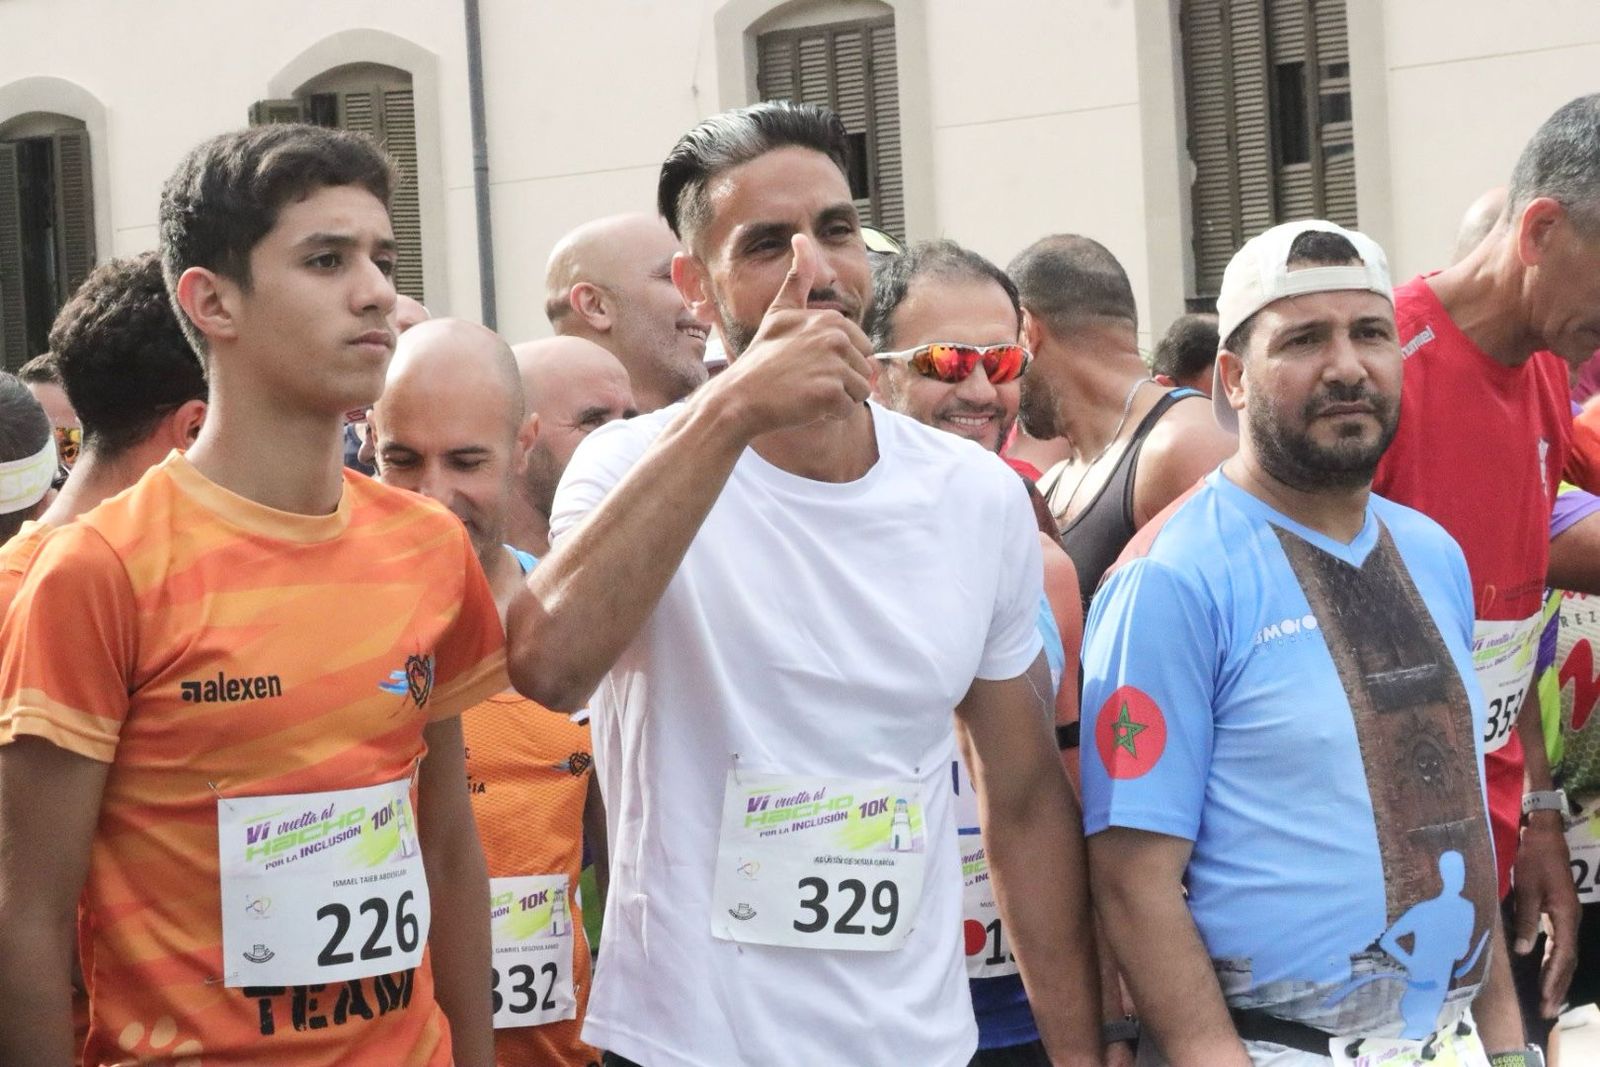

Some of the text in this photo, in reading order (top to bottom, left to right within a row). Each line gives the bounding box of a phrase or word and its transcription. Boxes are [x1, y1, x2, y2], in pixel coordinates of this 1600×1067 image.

[204, 671, 282, 703] alexen
[775, 791, 810, 808] vuelta
[813, 787, 826, 801] al
[859, 797, 890, 819] 10K
[277, 811, 318, 835] vuelta
[321, 803, 335, 821] al
[372, 800, 396, 831] 10K
[792, 810, 848, 832] INCLUSIÓN
[265, 825, 361, 870] POR LA INCLUSIÓN
[333, 878, 358, 888] ISMAEL
[519, 889, 549, 911] 10K
[793, 876, 899, 936] 329
[316, 890, 419, 966] 226
[243, 968, 416, 1035] TEAM
